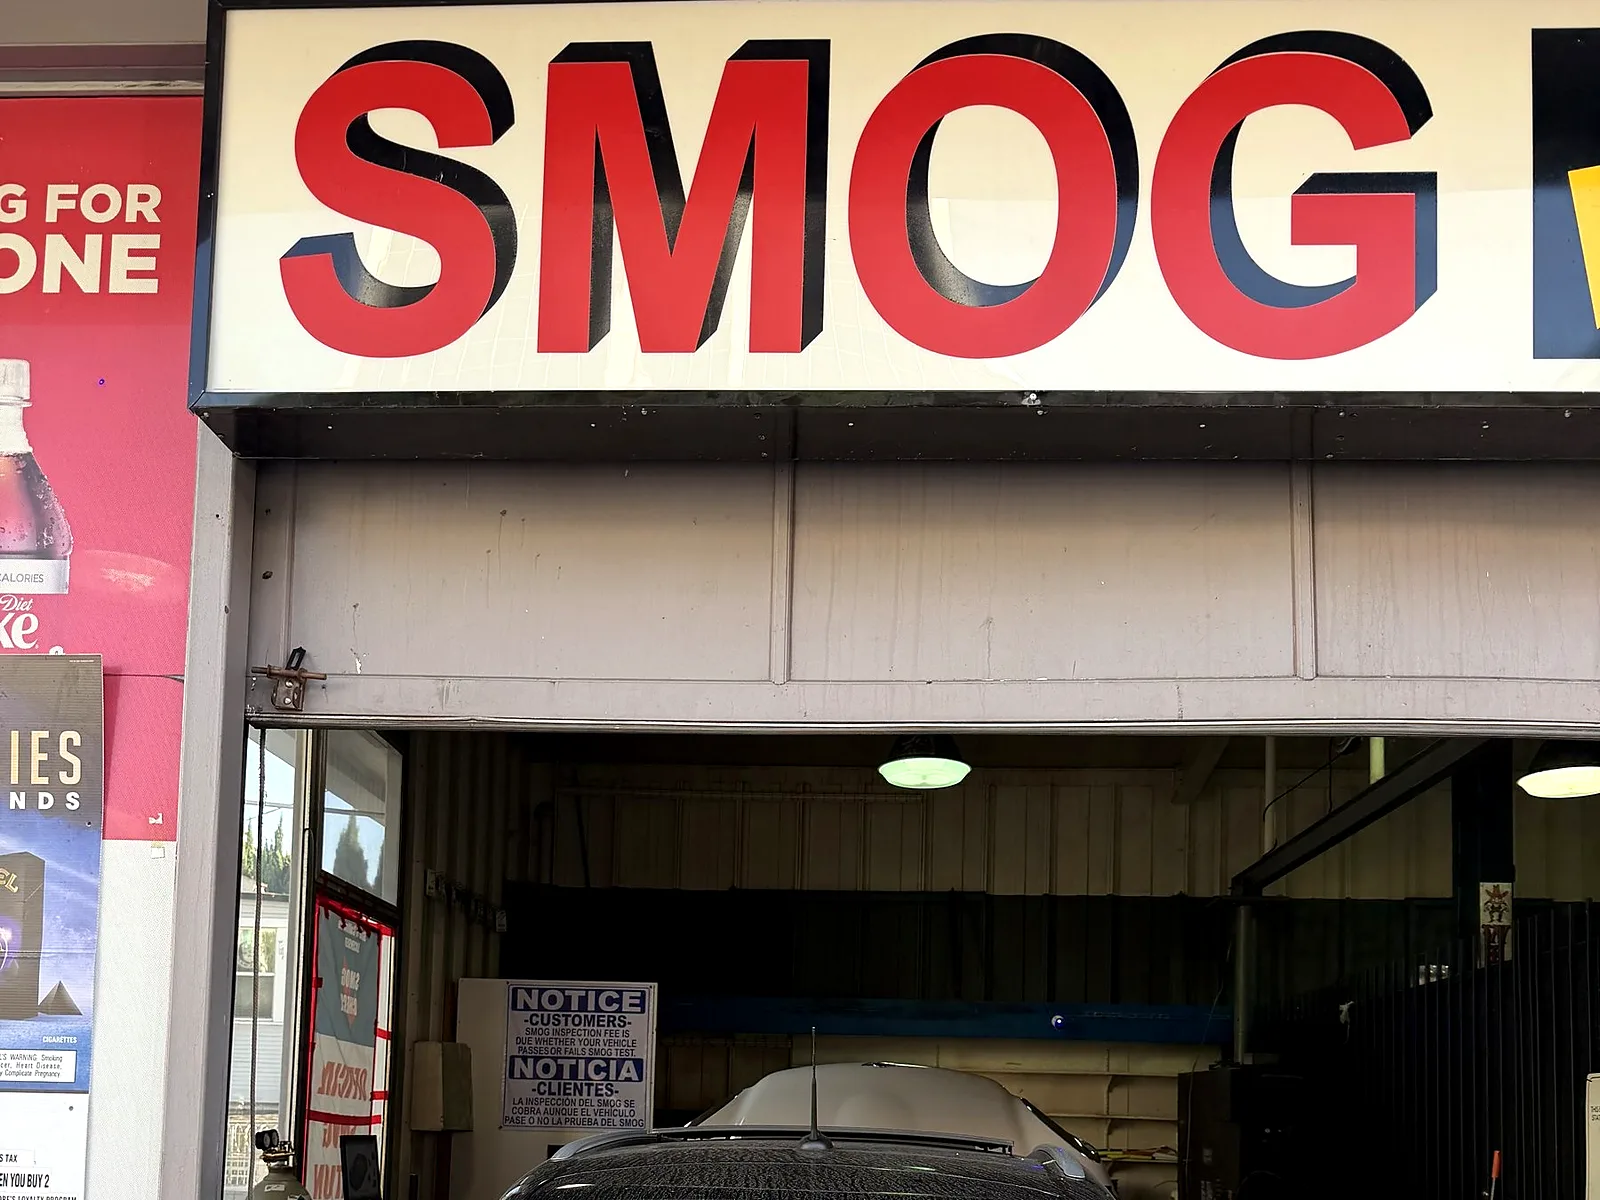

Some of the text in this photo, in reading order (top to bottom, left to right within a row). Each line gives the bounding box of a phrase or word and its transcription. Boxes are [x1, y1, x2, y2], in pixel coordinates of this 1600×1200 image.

[280, 30, 1437, 360] SMOG
[45, 183, 162, 223] FOR
[0, 232, 161, 294] ONE
[0, 573, 44, 583] ALORIES
[0, 594, 33, 611] Diet
[10, 730, 81, 785] IES
[9, 791, 80, 810] NDS
[516, 988, 642, 1012] NOTICE
[524, 1013, 632, 1028] -CUSTOMERS-
[525, 1028, 630, 1038] SMOG INSPECTION FEE IS
[516, 1037, 637, 1047] DUE WHETHER YOUR VEHICLE
[41, 1054, 63, 1063] Smoking
[518, 1046, 637, 1057] PASSES OR FAILS SMOG TEST.
[5, 1069, 32, 1078] Complicate
[513, 1057, 640, 1081] NOTICIA
[531, 1082, 619, 1097] -CLIENTES-
[512, 1097, 635, 1108] LA INSPECCIÓN DEL SMOG SE
[512, 1107, 542, 1115] COBRA
[543, 1107, 579, 1116] AUNQUE
[581, 1108, 592, 1116] EL
[504, 1116, 645, 1128] PASE O NO LA PRUEBA DEL SMOG
[5, 1154, 18, 1163] TAX
[10, 1173, 26, 1188] YOU
[27, 1174, 43, 1188] BUY
[44, 1174, 50, 1188] 2
